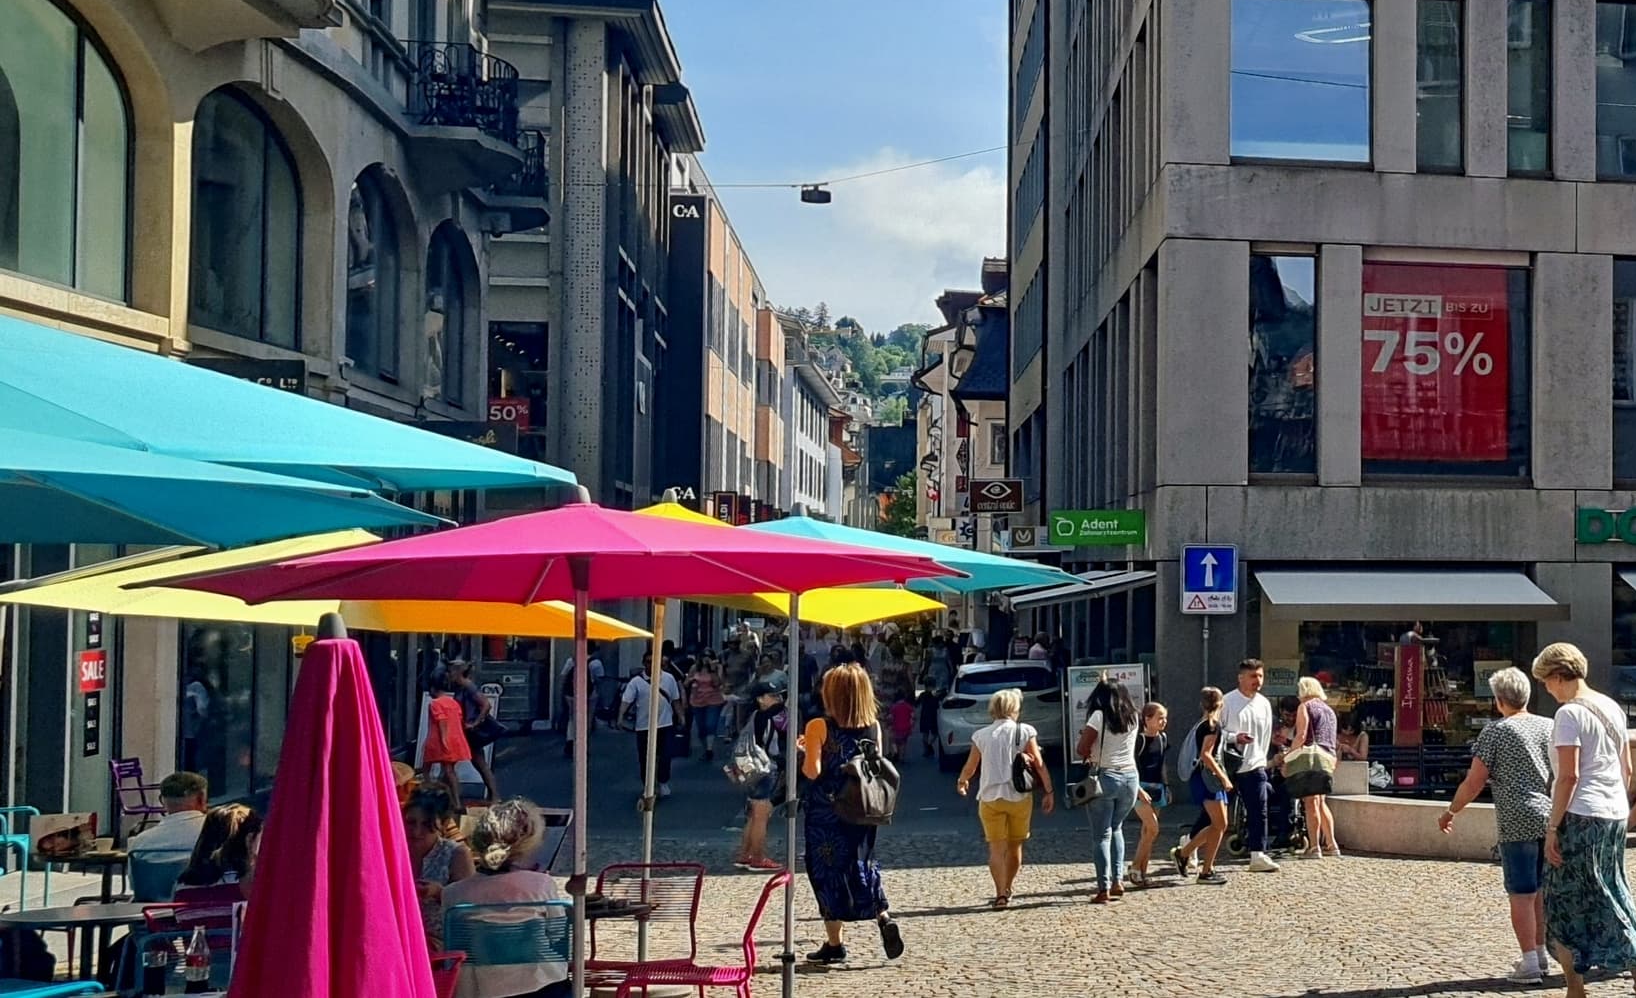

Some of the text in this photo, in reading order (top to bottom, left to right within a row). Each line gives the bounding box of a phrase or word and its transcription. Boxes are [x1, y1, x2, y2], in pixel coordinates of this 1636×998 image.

[672, 203, 700, 219] C&A
[1369, 297, 1489, 315] JETZT BIS ZU
[1363, 329, 1494, 376] 75%
[488, 404, 529, 421] 50%
[1080, 518, 1120, 531] Adent
[81, 660, 105, 682] SALE
